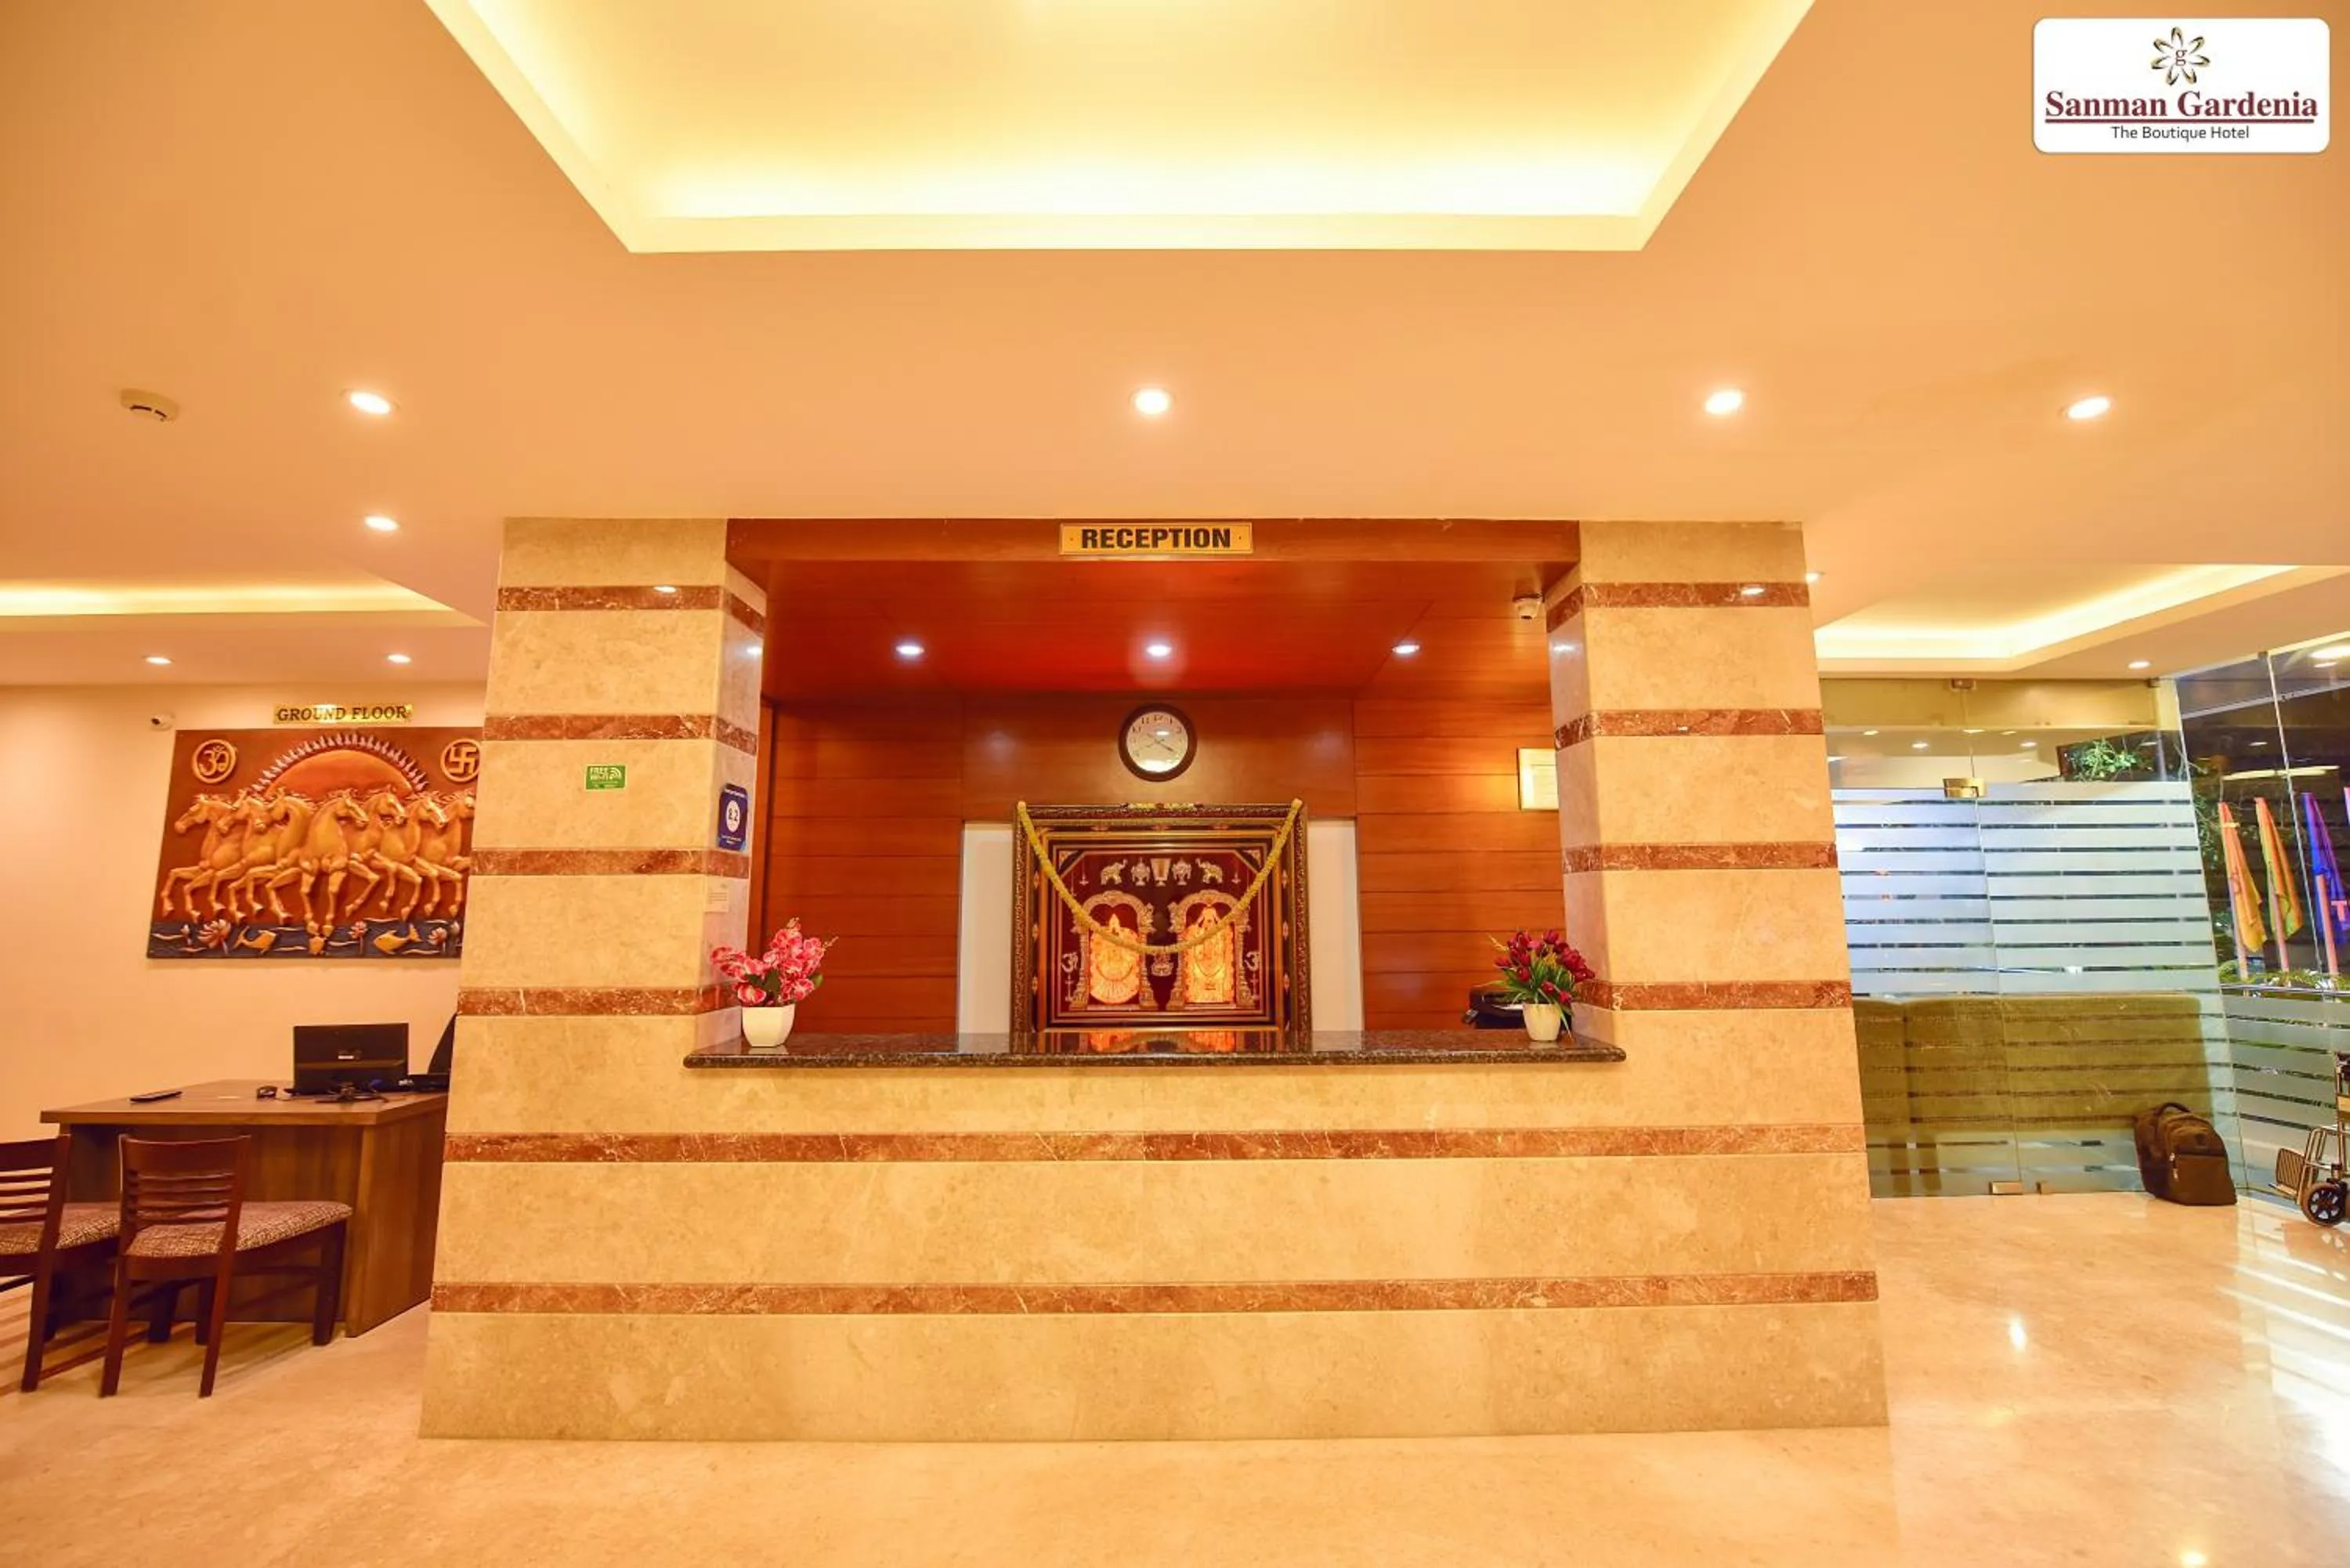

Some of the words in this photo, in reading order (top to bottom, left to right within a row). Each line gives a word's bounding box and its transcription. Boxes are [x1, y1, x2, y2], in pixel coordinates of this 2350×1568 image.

[1081, 528, 1231, 548] RECEPTION
[277, 706, 346, 721] GROUND
[351, 706, 407, 720] FLOOR
